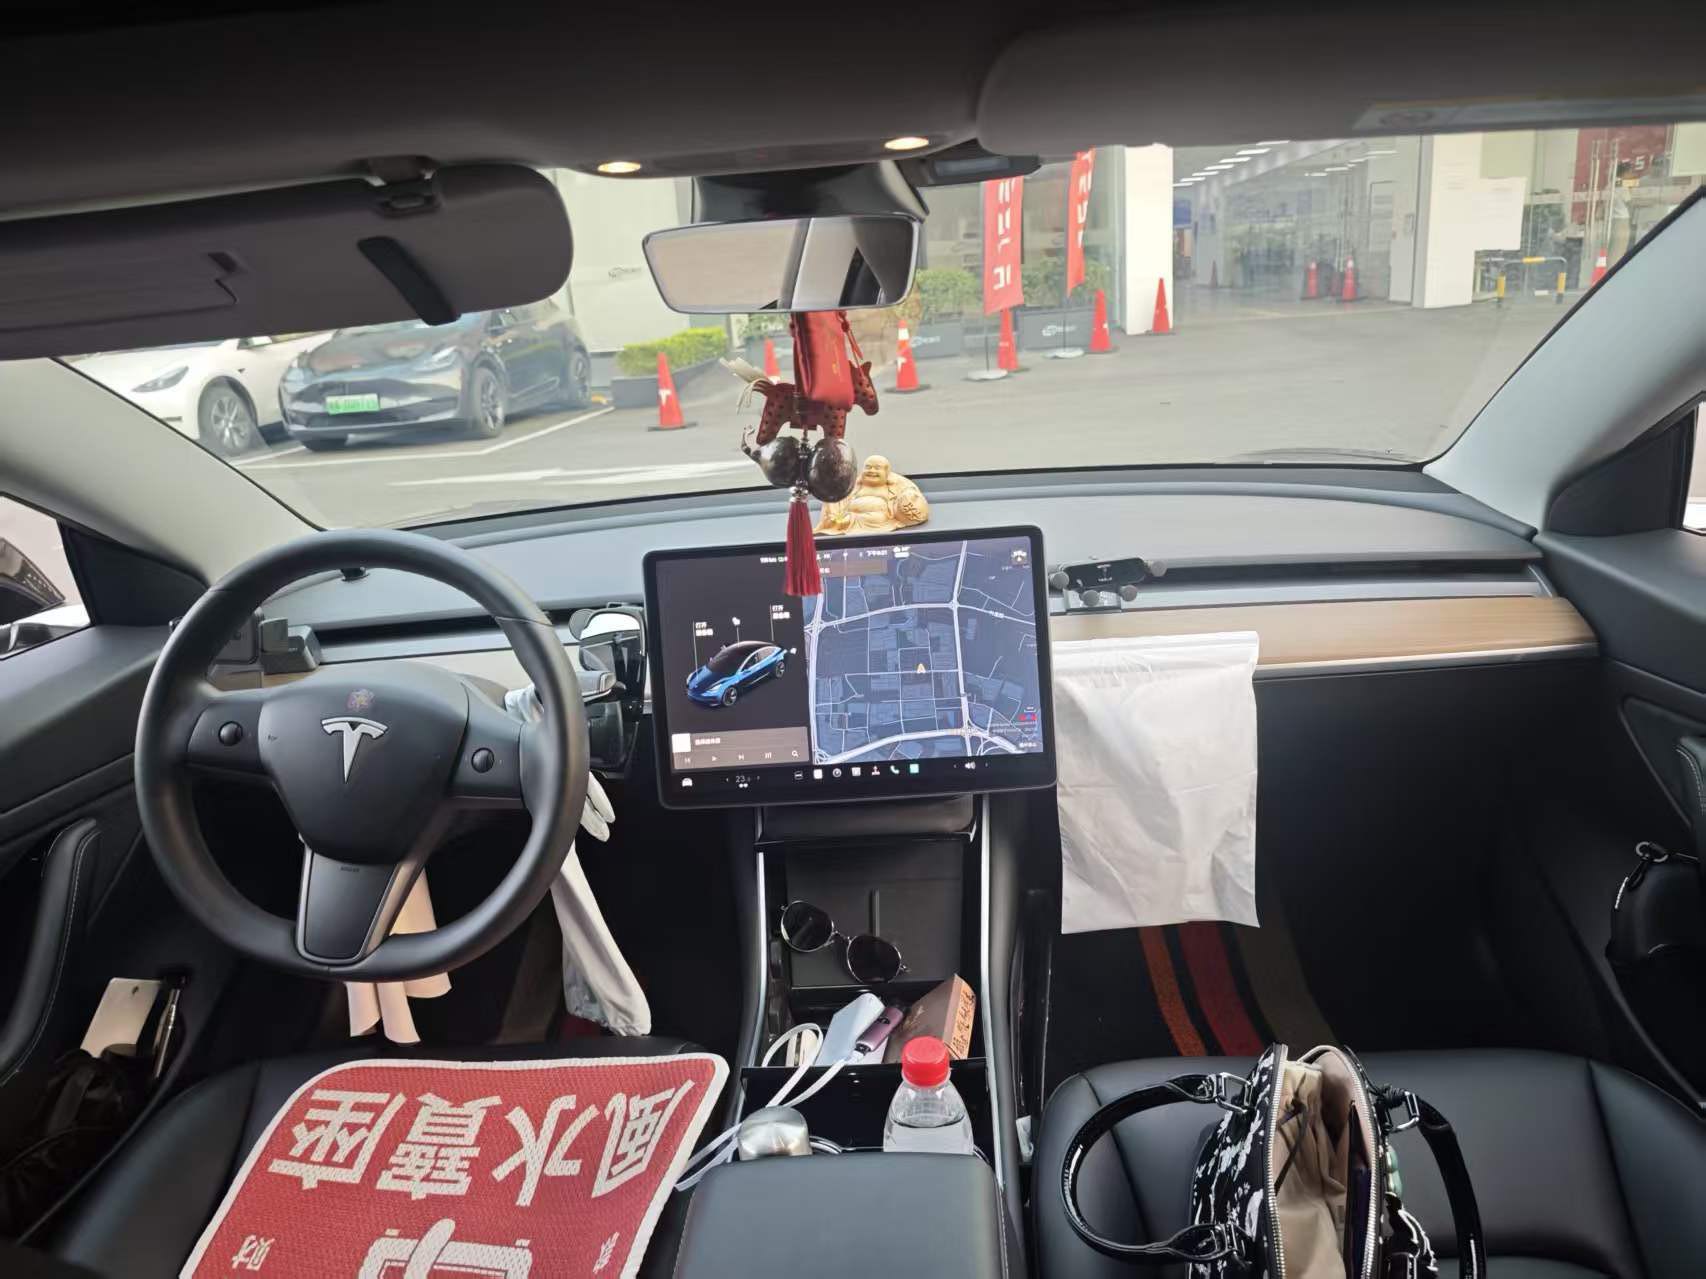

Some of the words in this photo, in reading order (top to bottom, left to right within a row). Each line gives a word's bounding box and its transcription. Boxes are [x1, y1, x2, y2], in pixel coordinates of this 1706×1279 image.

[268, 1079, 695, 1207] 風水寶座
[231, 1234, 276, 1271] 财
